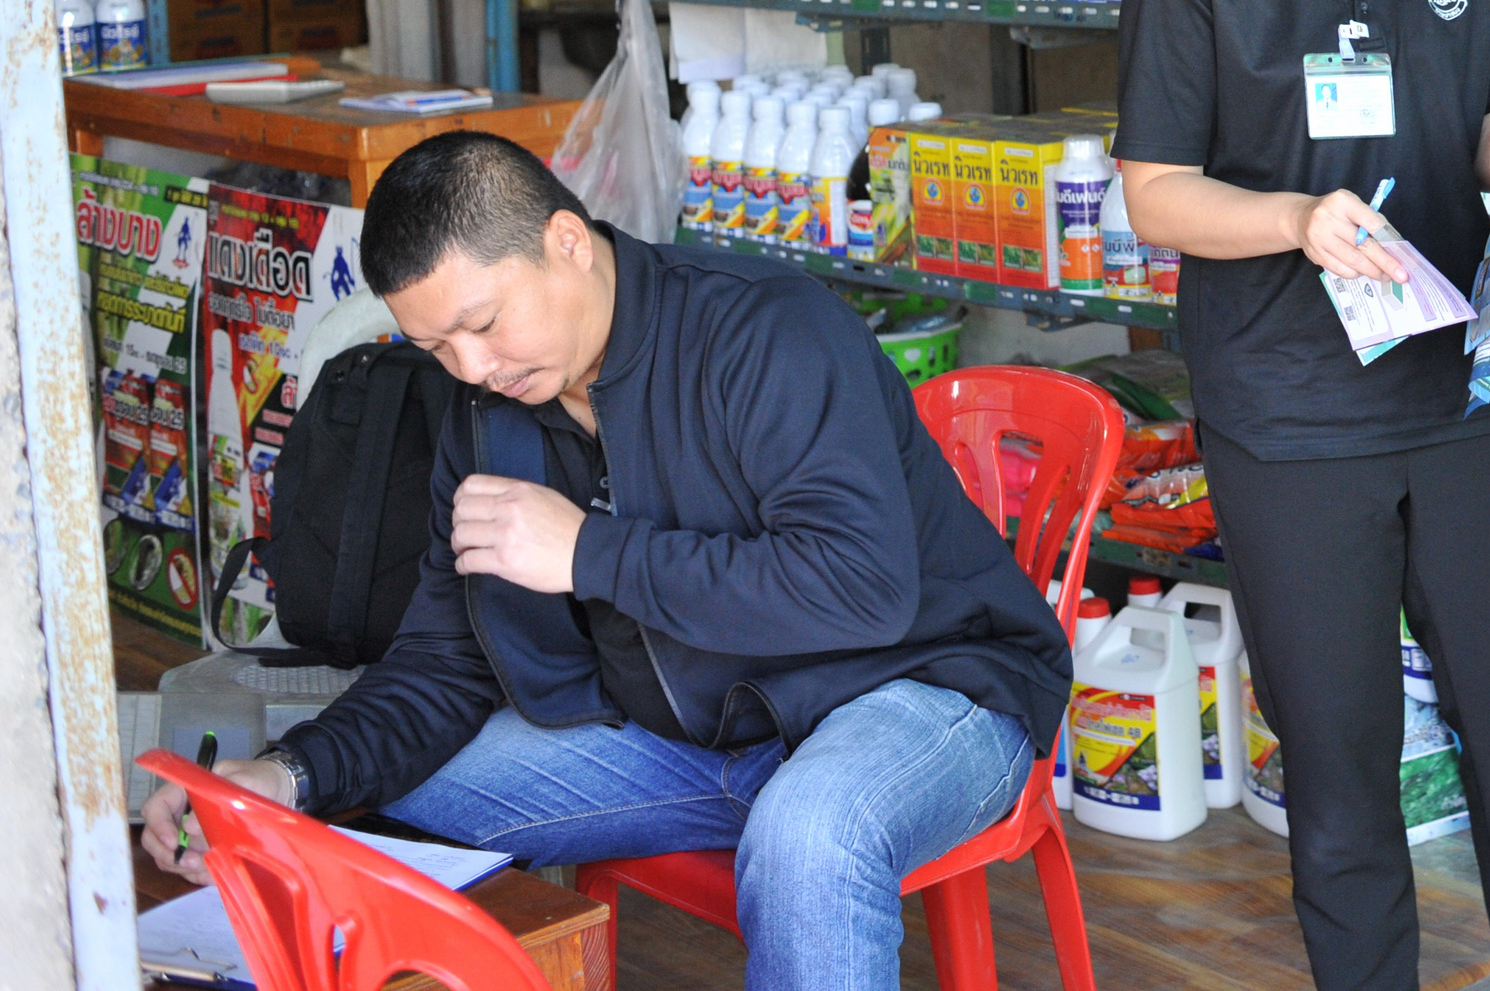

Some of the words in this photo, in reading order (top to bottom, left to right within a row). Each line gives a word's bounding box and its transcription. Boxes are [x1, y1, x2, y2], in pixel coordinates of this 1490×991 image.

[76, 188, 162, 262] ล้างบาง
[208, 227, 314, 303] แดงเดือด
